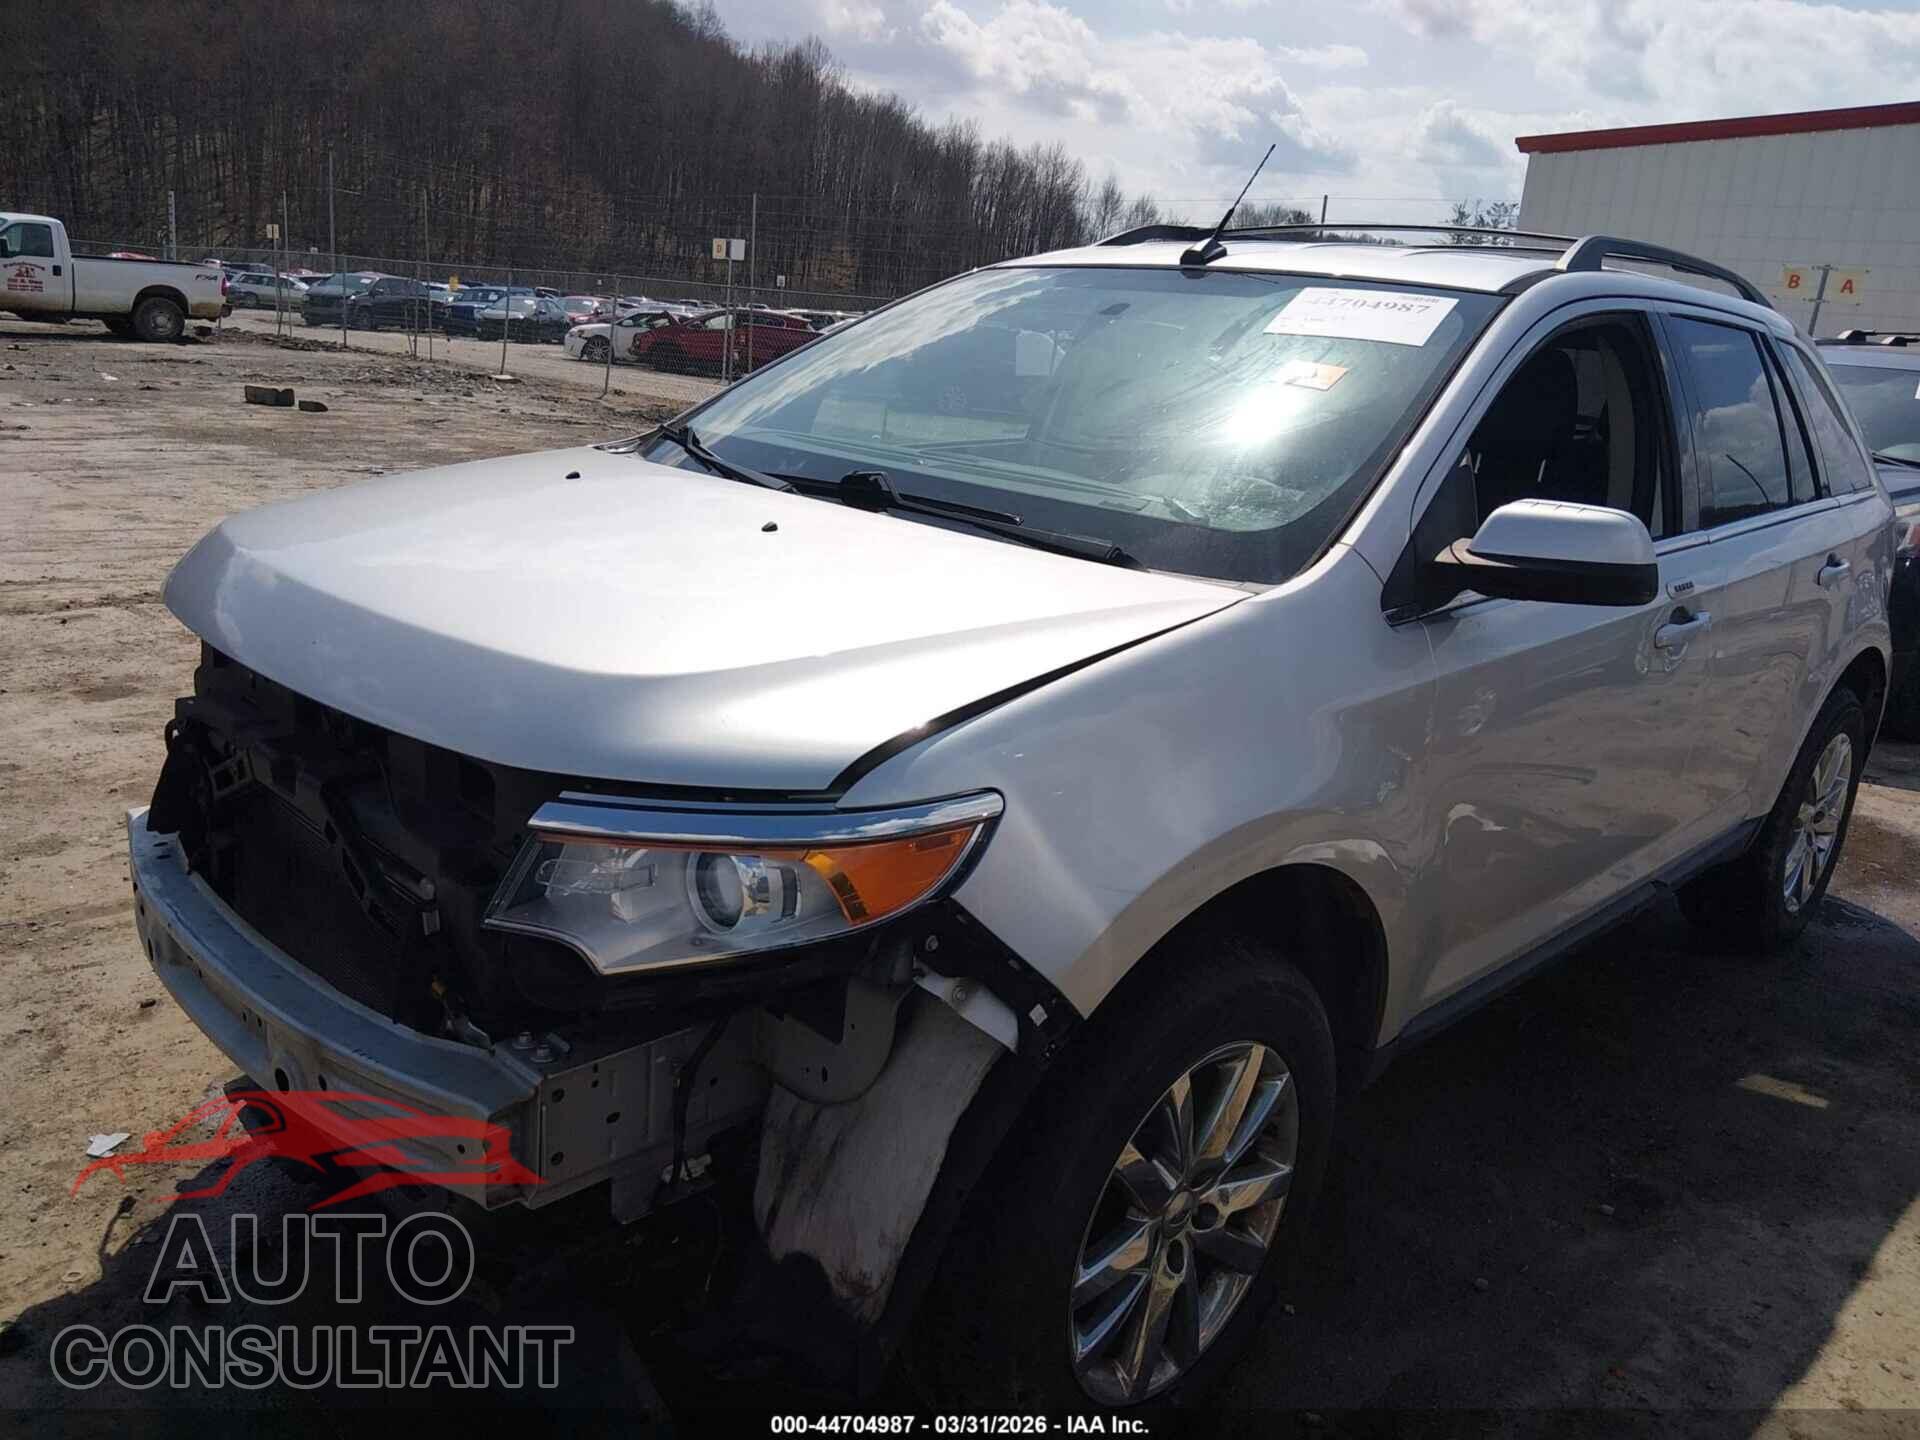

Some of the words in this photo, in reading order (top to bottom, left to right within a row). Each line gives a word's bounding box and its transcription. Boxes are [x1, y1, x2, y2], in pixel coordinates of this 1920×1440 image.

[1788, 274, 1801, 289] B
[1840, 279, 1854, 294] A
[1310, 297, 1432, 314] 4704987
